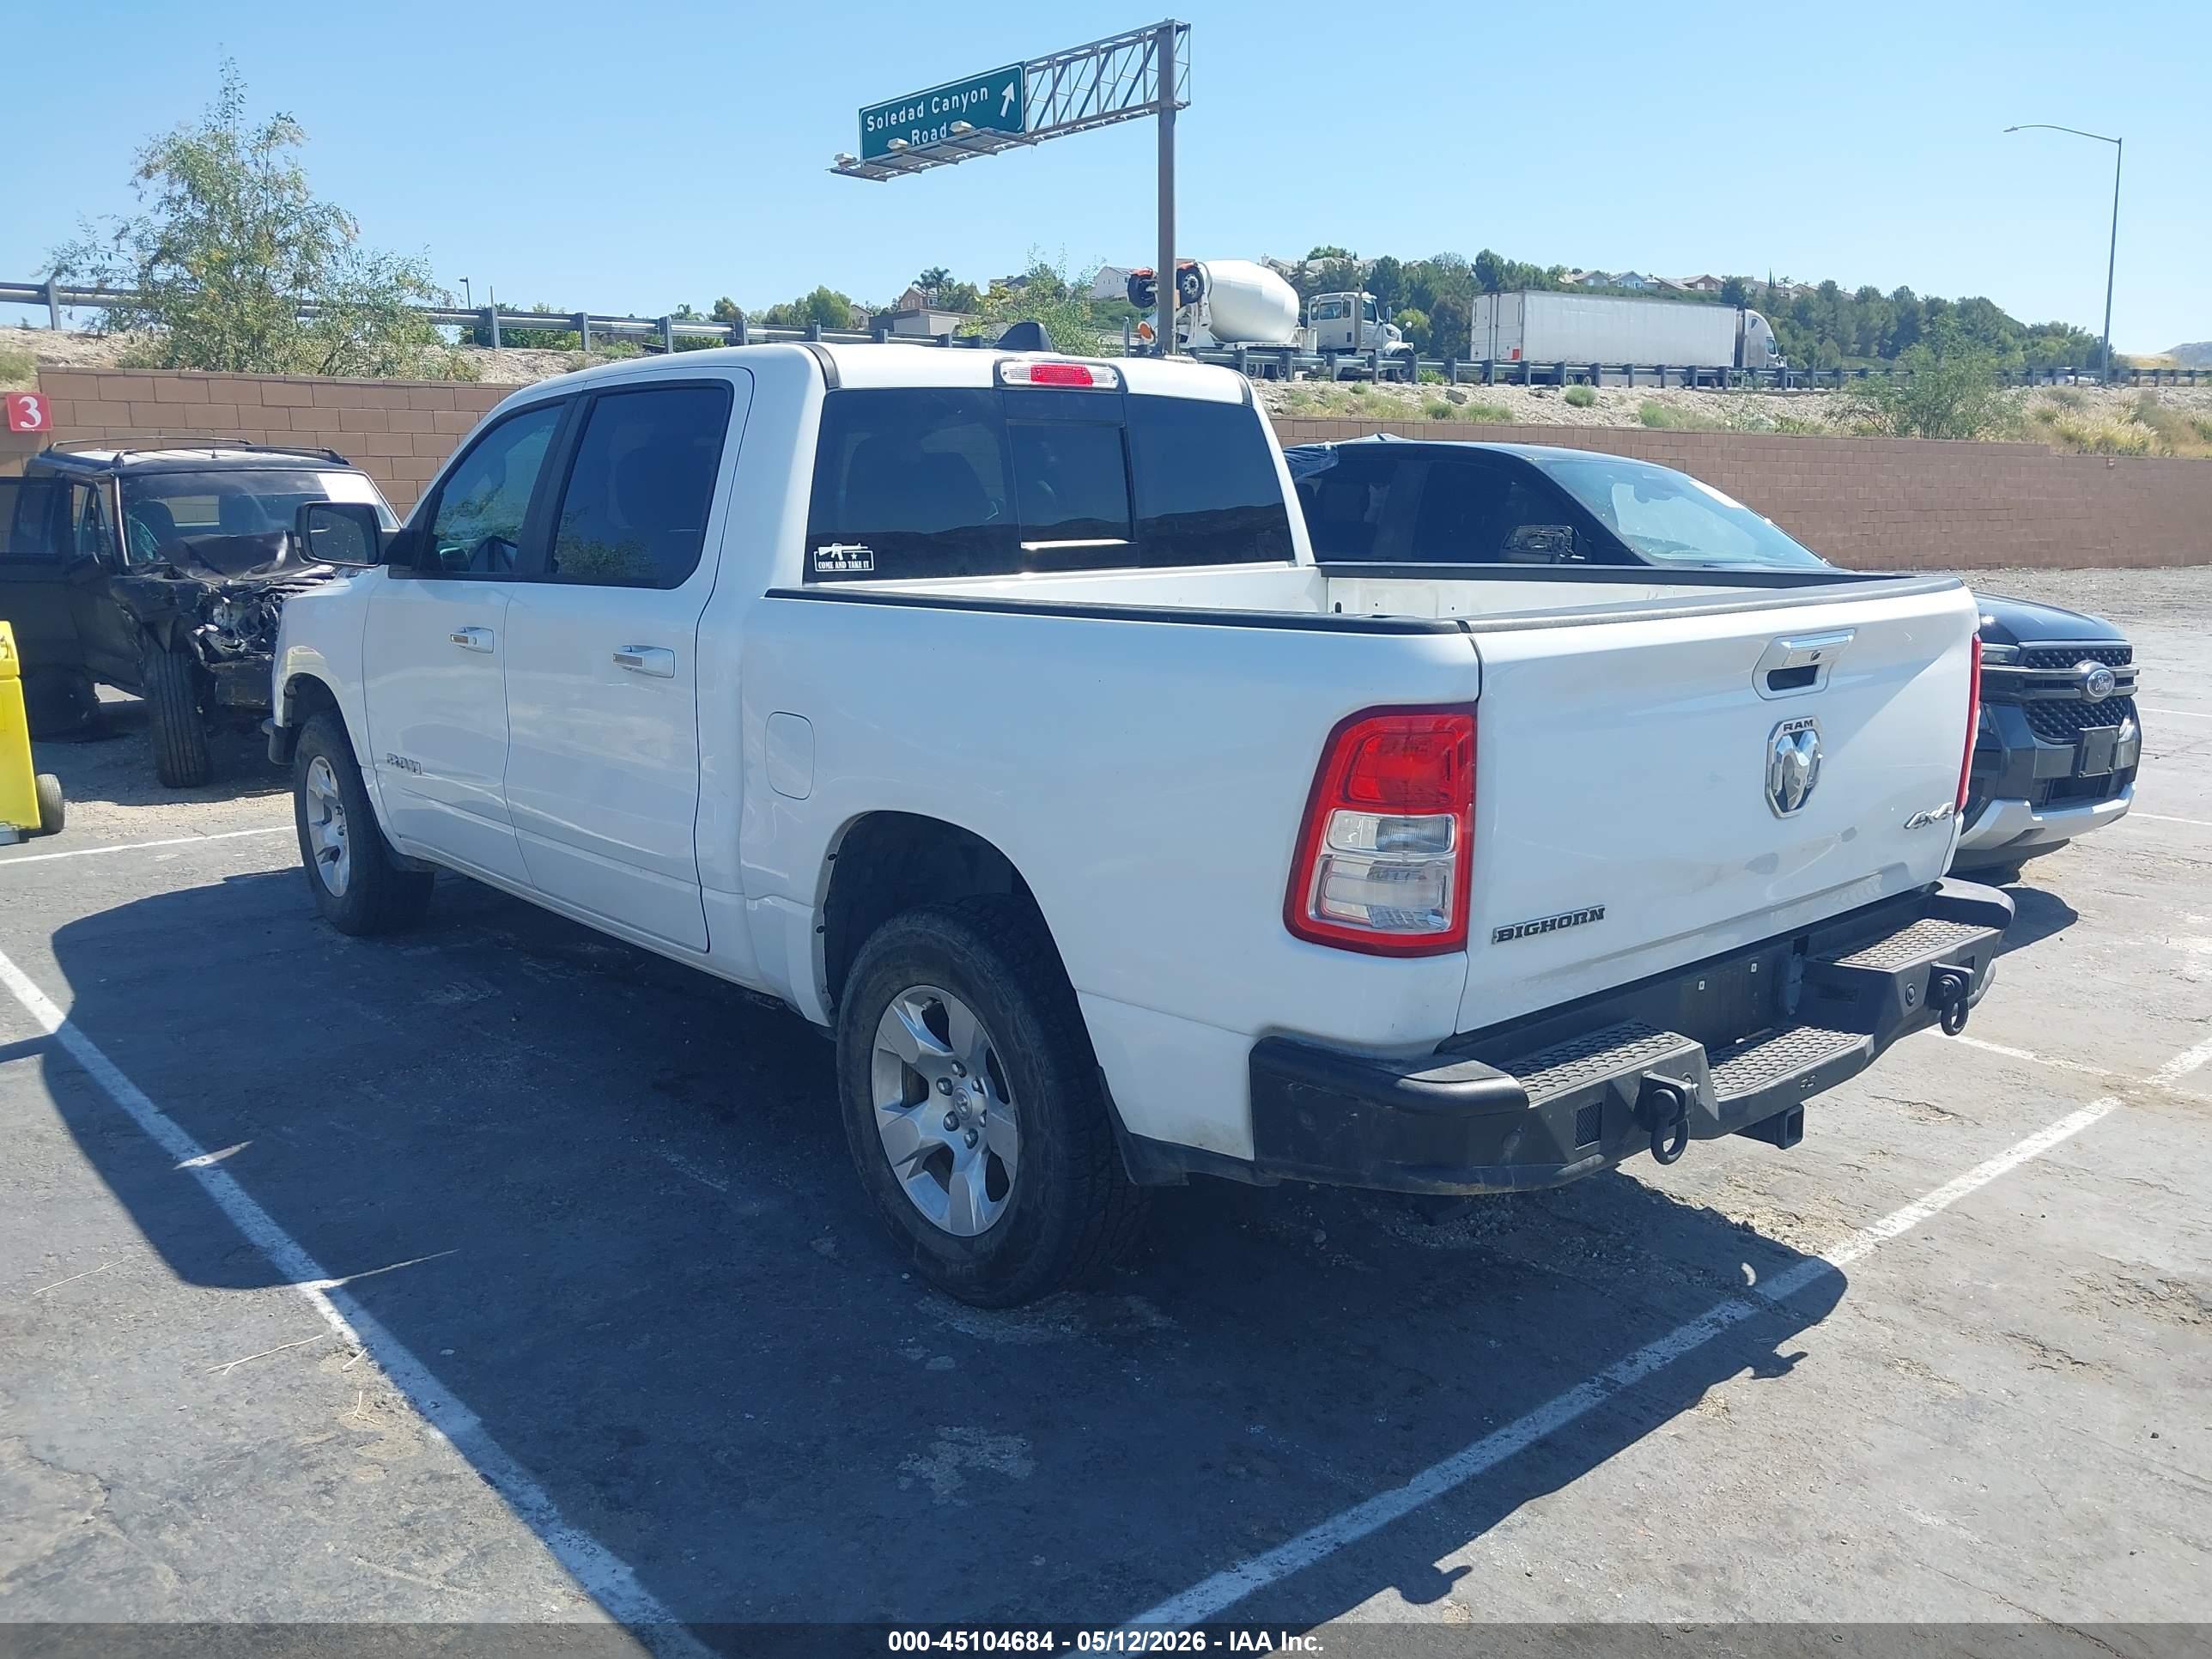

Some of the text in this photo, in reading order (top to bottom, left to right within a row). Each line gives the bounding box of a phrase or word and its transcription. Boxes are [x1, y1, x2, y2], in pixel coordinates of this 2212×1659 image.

[866, 87, 988, 132] Soledad Canyon
[911, 122, 947, 146] Road
[19, 396, 42, 428] 3
[817, 561, 834, 569] COME
[1783, 719, 1814, 732] RAM
[386, 752, 422, 775] RAM
[1492, 904, 1606, 945] BIGHORN
